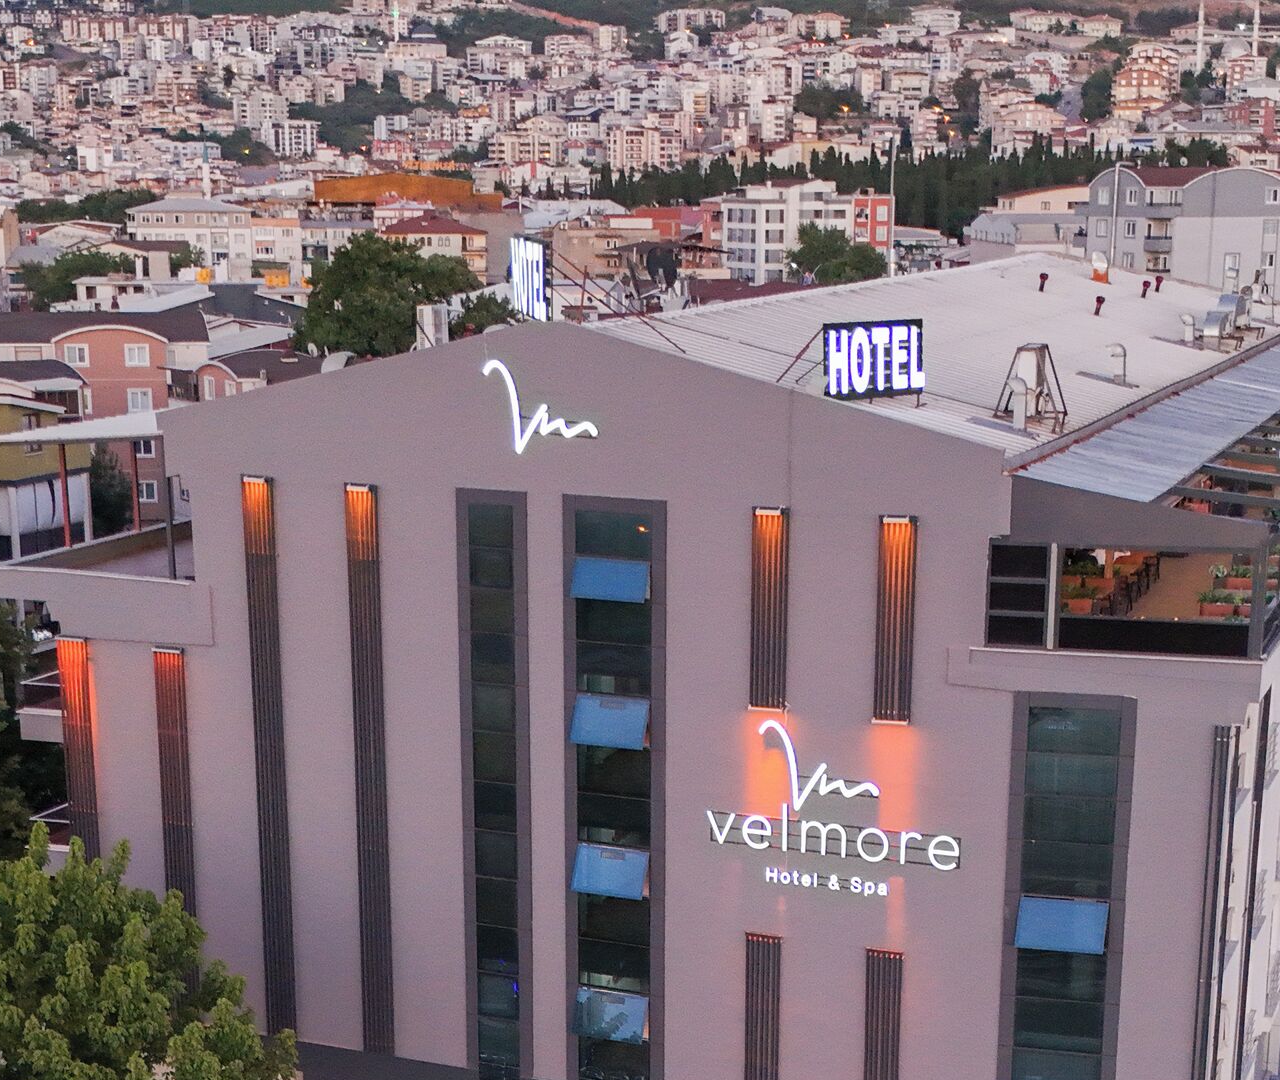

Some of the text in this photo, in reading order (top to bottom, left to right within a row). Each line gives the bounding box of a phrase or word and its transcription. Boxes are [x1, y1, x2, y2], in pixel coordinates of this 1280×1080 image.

[510, 237, 547, 322] HOTEL
[828, 325, 925, 395] HOTEL
[706, 803, 961, 871] velmore
[765, 866, 889, 897] Hotel & Spa
